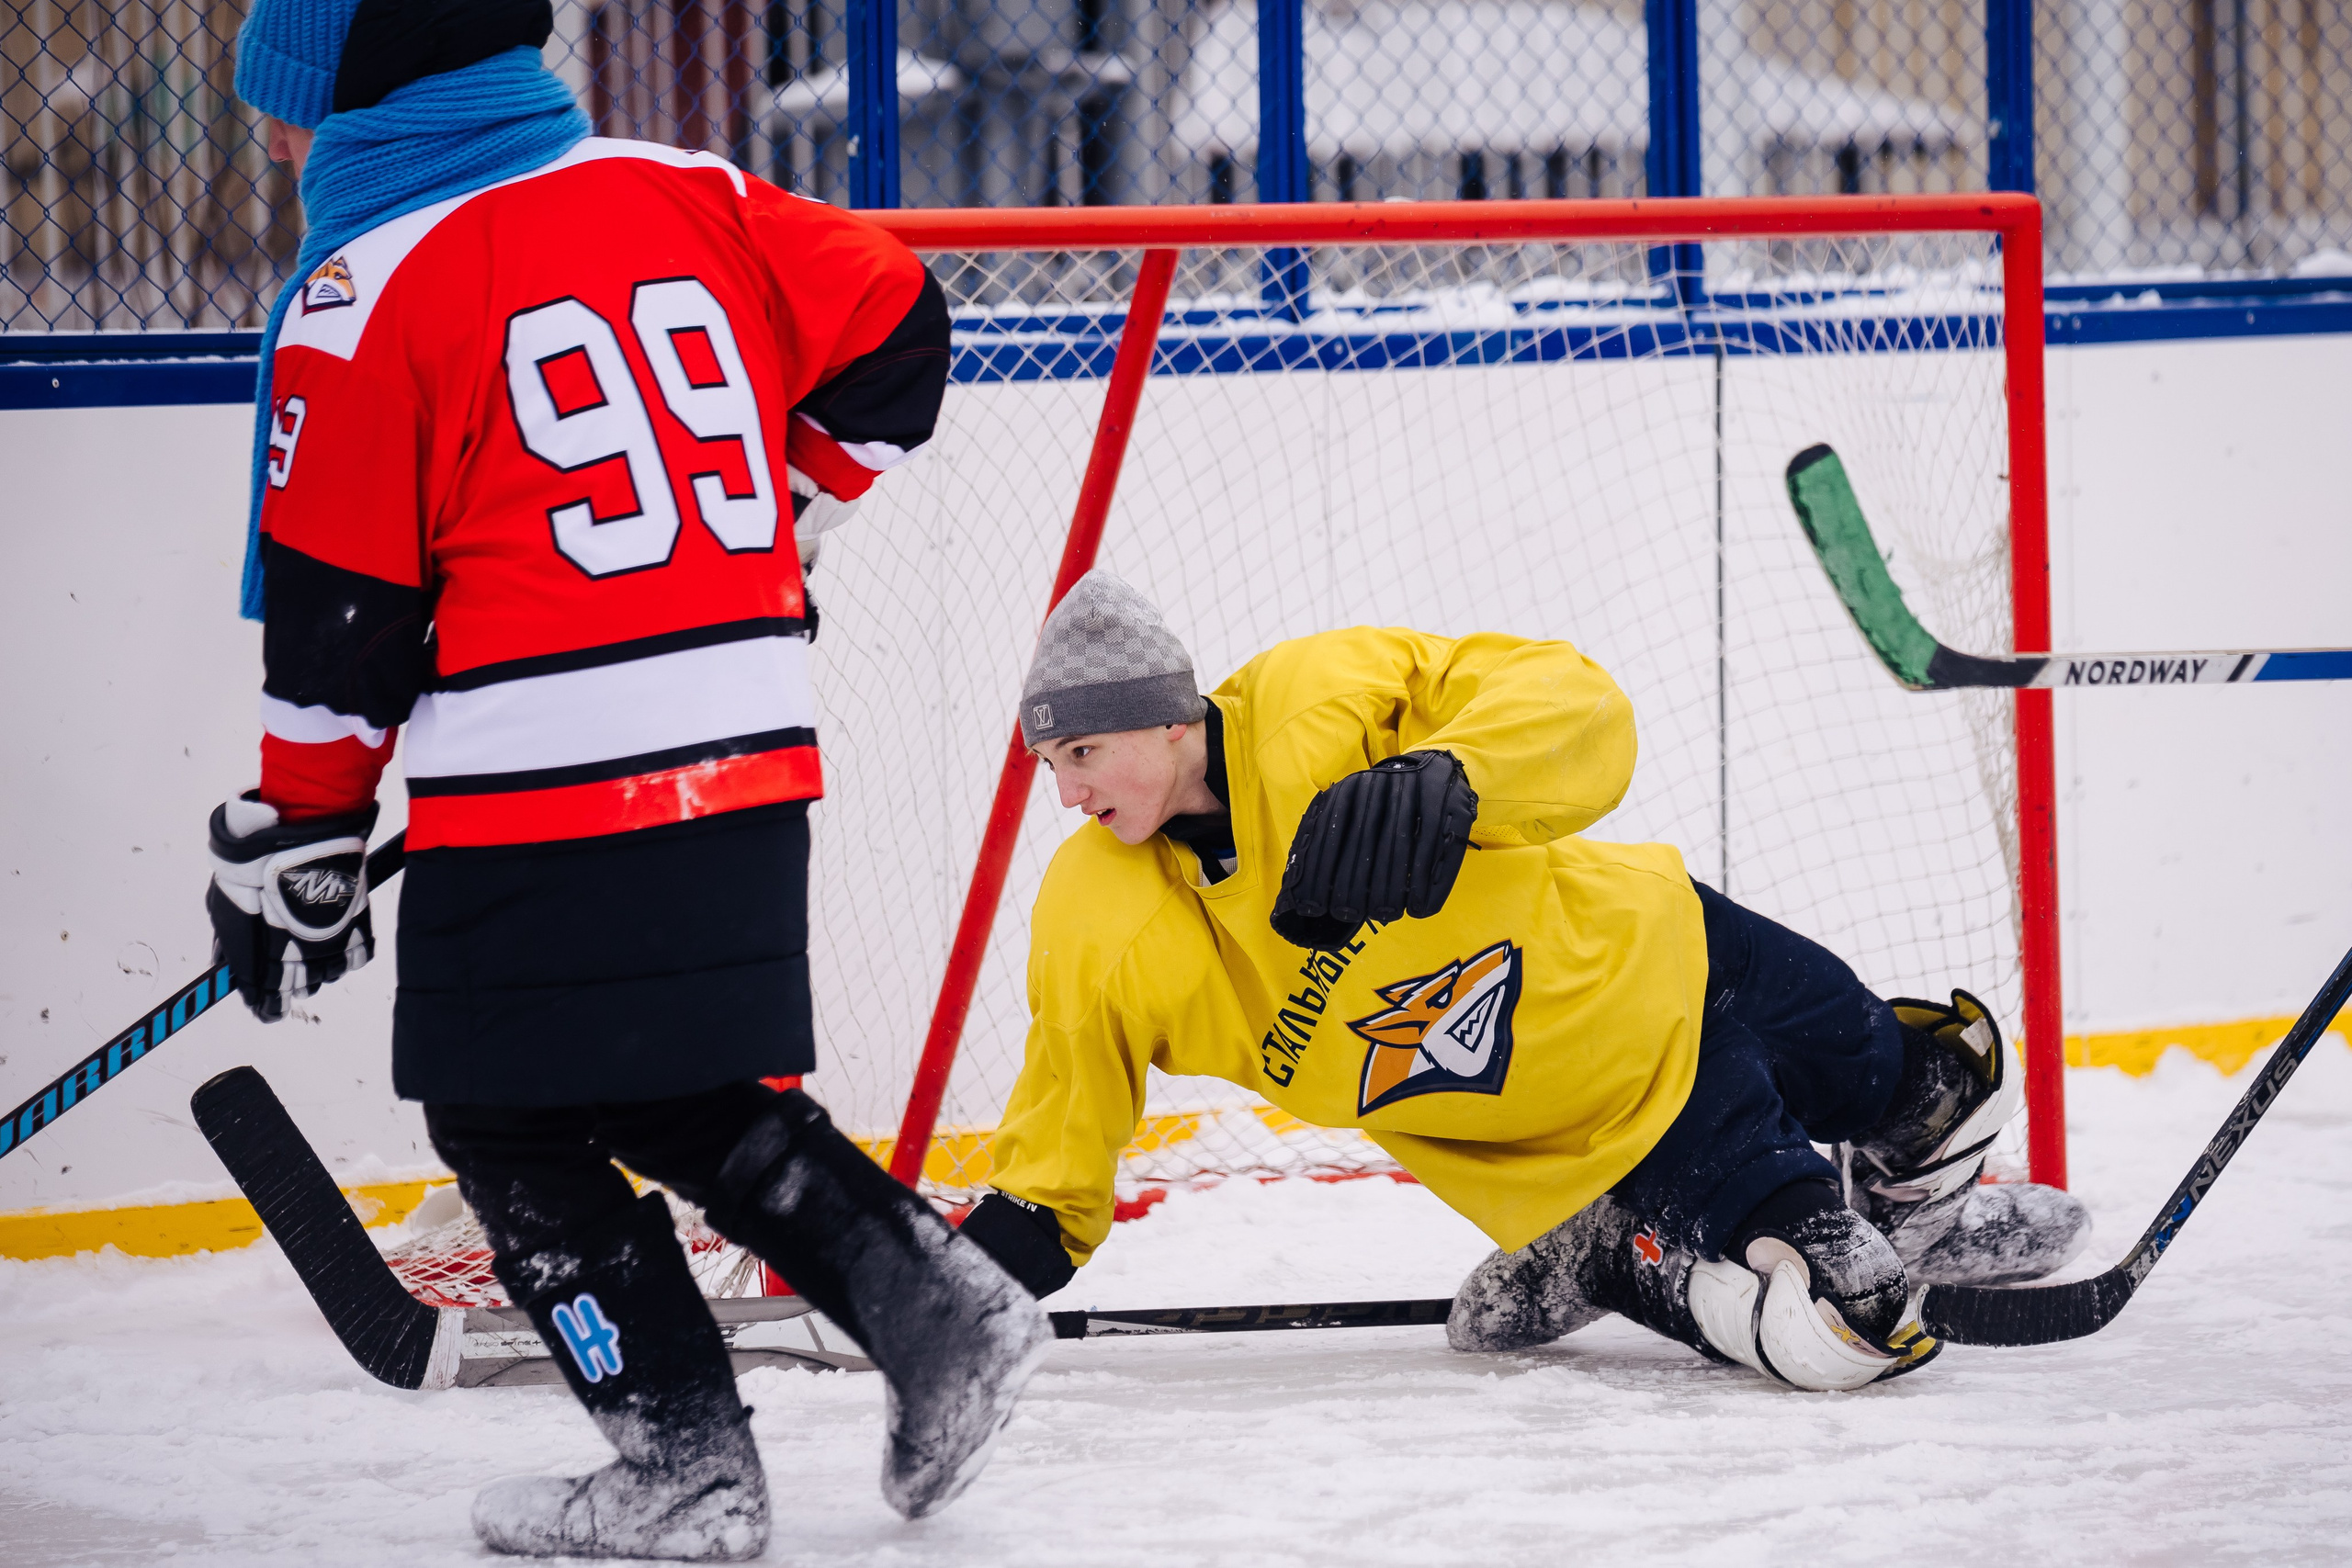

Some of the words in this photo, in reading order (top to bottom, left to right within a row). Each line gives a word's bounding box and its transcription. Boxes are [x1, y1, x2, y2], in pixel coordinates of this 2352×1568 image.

[502, 275, 778, 581] 99
[2064, 658, 2209, 685] NORDWAY
[2187, 1053, 2298, 1201] NEXUS
[1001, 1190, 1026, 1208] STRIKE
